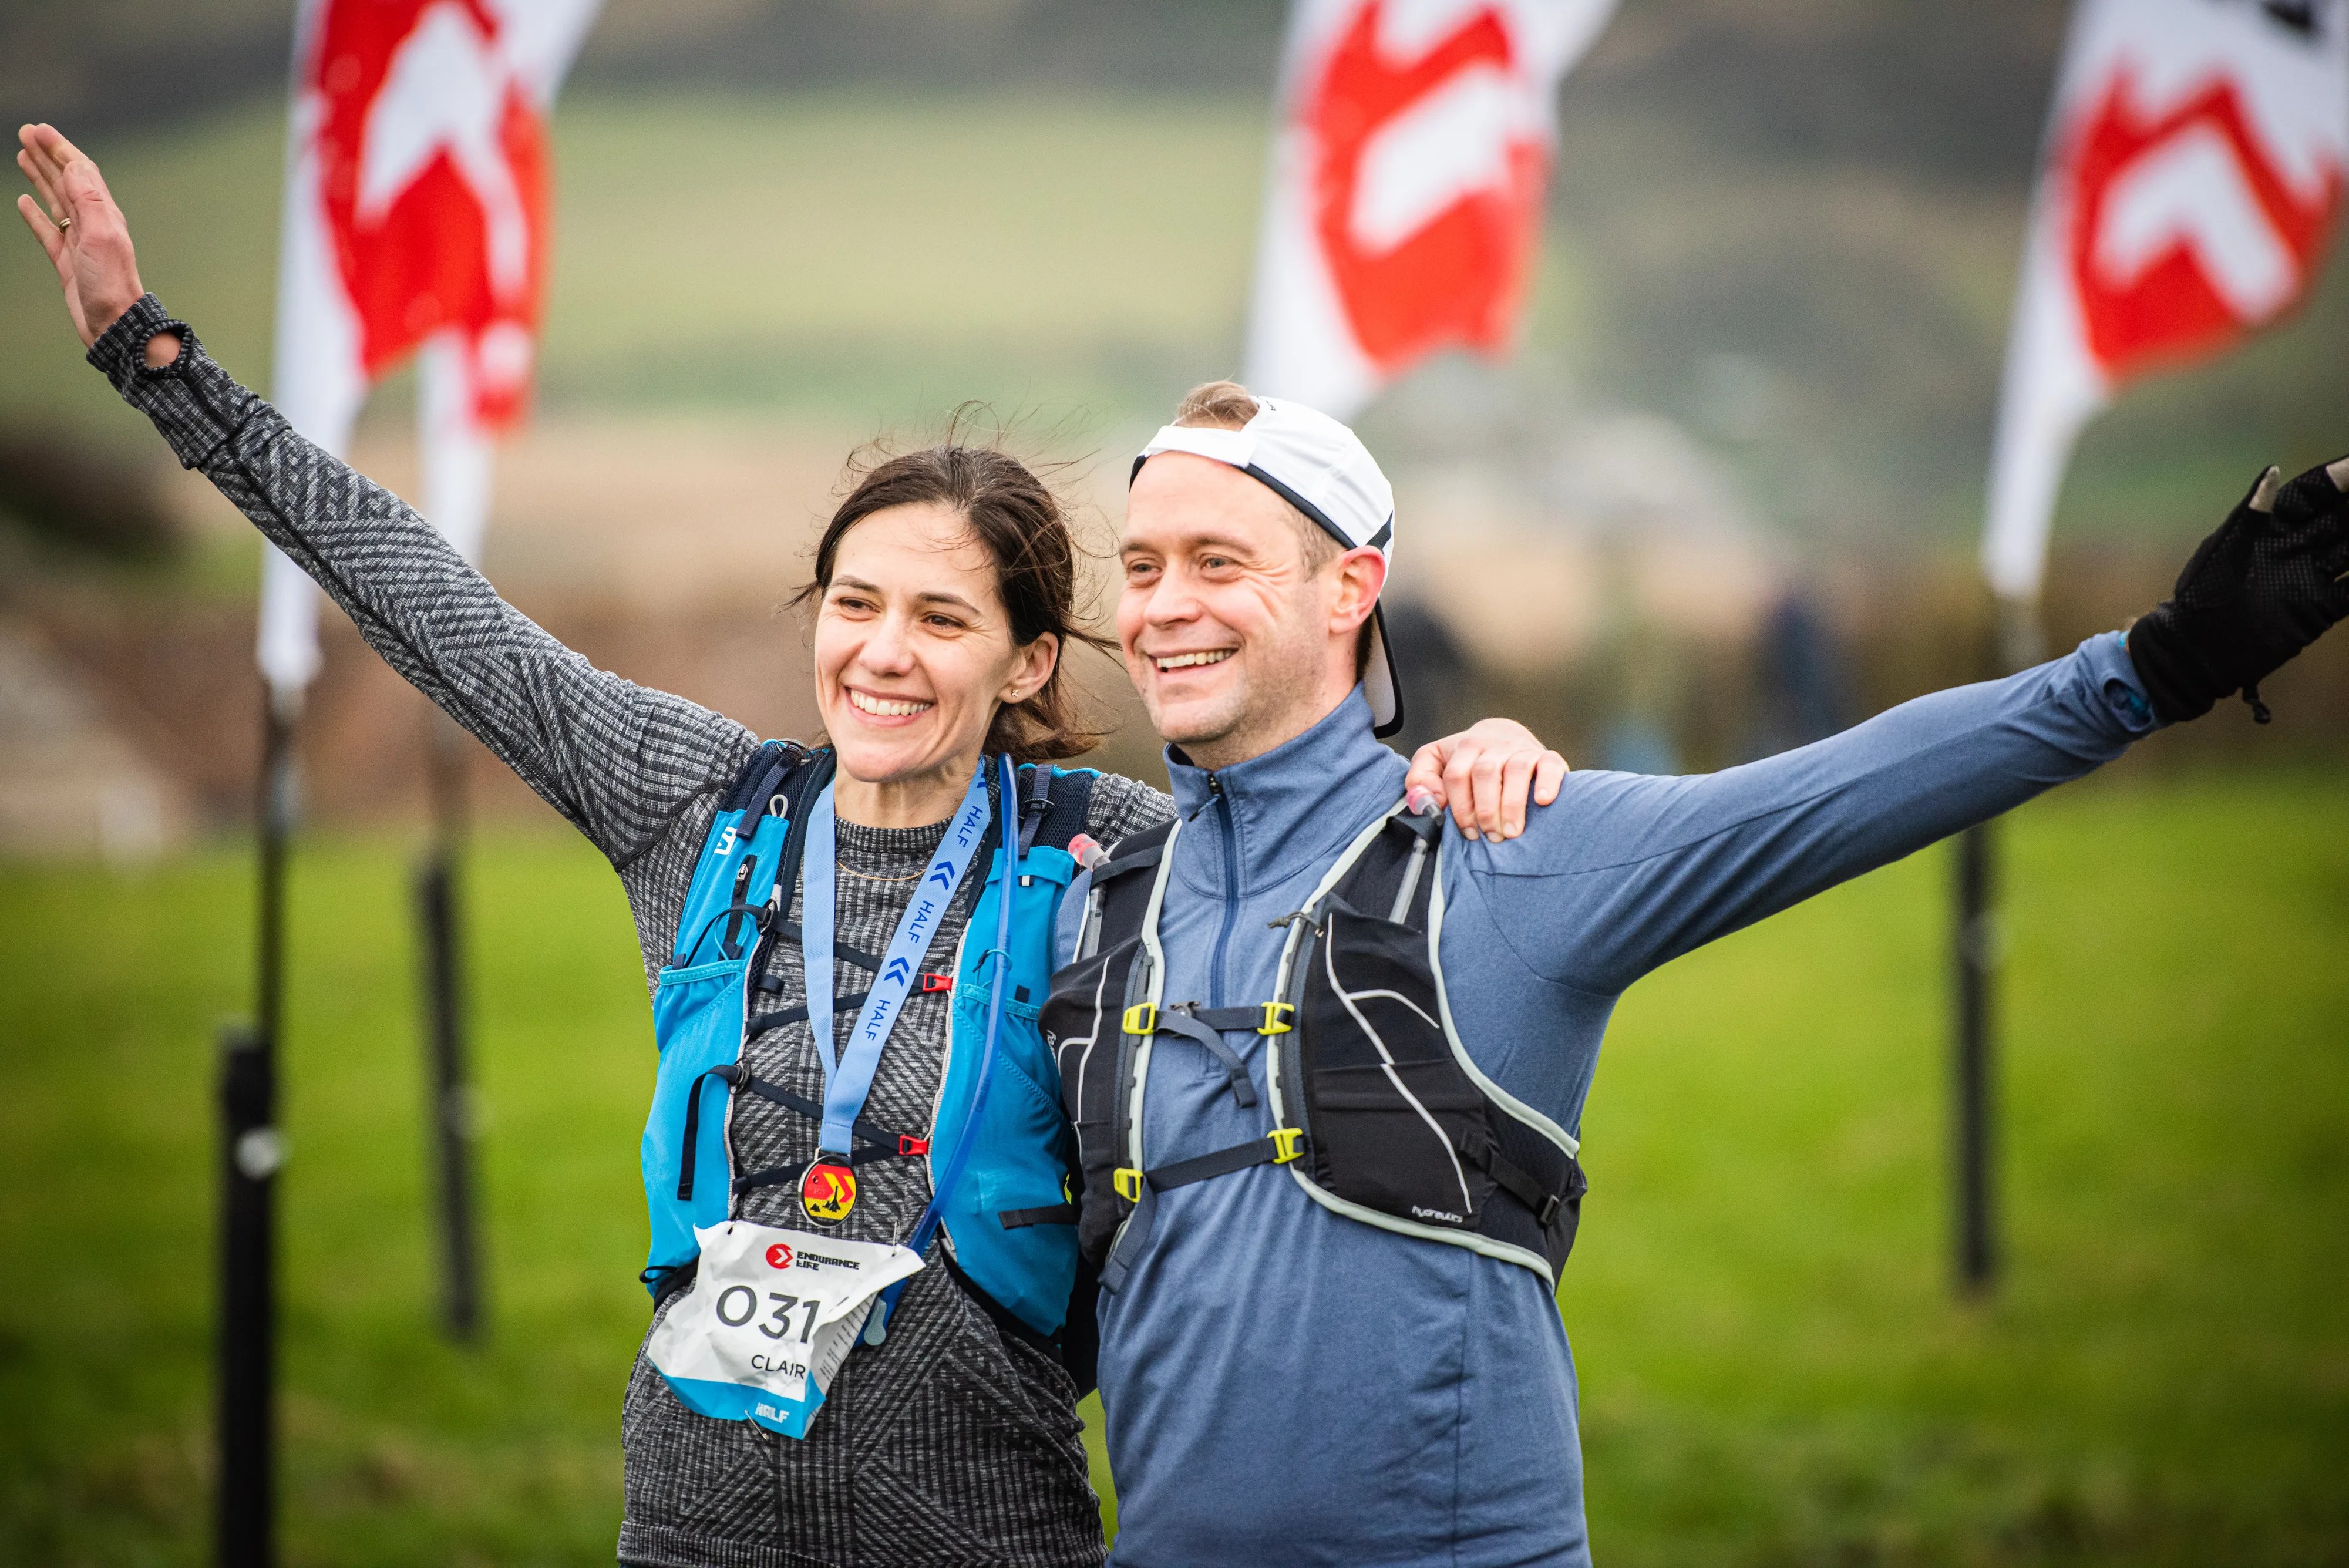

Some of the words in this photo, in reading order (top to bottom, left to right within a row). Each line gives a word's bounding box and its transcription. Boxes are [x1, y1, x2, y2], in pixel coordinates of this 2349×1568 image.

[957, 805, 983, 848] HALF
[908, 900, 935, 943] HALF
[865, 999, 891, 1041] HALF
[796, 1260, 820, 1271] LIFE
[797, 1251, 860, 1270] ENDURANCE
